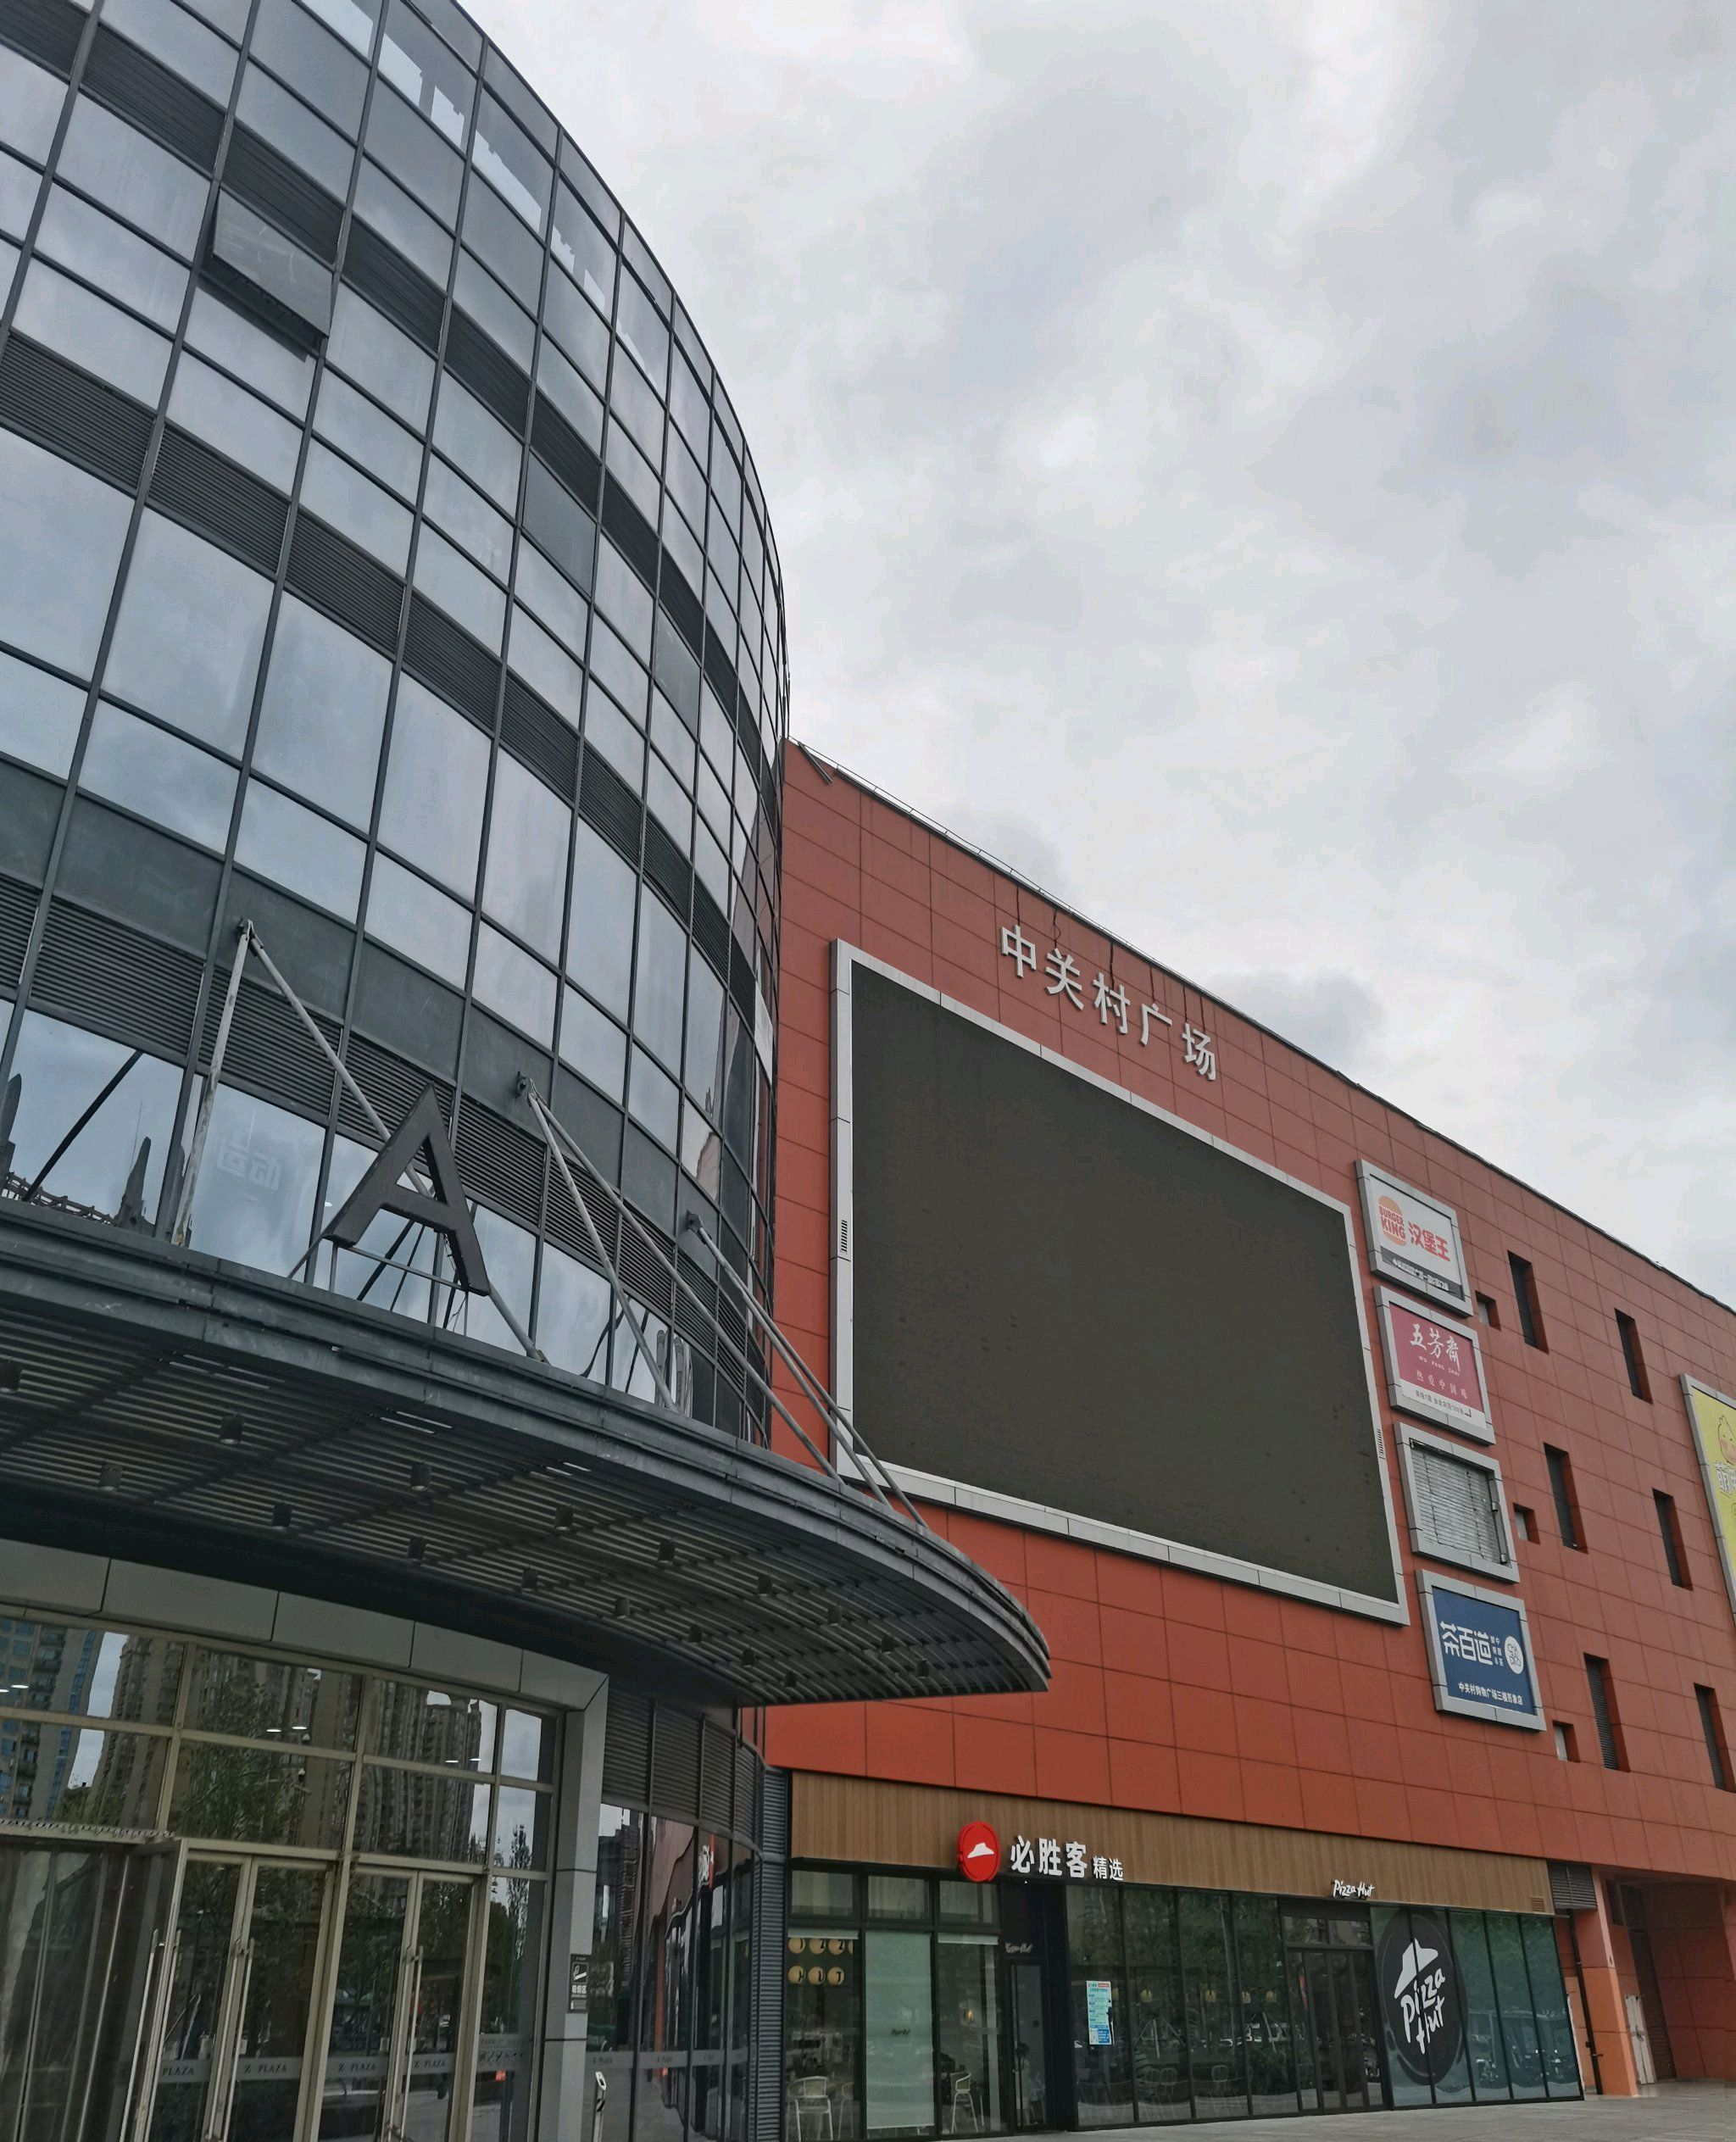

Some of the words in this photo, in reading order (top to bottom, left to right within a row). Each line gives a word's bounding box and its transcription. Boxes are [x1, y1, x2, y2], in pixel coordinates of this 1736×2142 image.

[1001, 924, 1216, 1081] 中关村广场
[323, 1081, 490, 1296] A
[1379, 1205, 1405, 1227] BURGER
[1380, 1216, 1406, 1240] KING
[1408, 1221, 1450, 1262] 汉堡王
[1440, 1621, 1494, 1666] 茶百道
[1010, 1834, 1088, 1878] 必胜客
[1093, 1855, 1123, 1880] 精选
[1333, 1879, 1356, 1897] Pizza
[1357, 1881, 1375, 1897] Hut
[1400, 1967, 1445, 2044] Pizza
[1416, 1995, 1445, 2054] Hut
[258, 2063, 287, 2073] PLAZA
